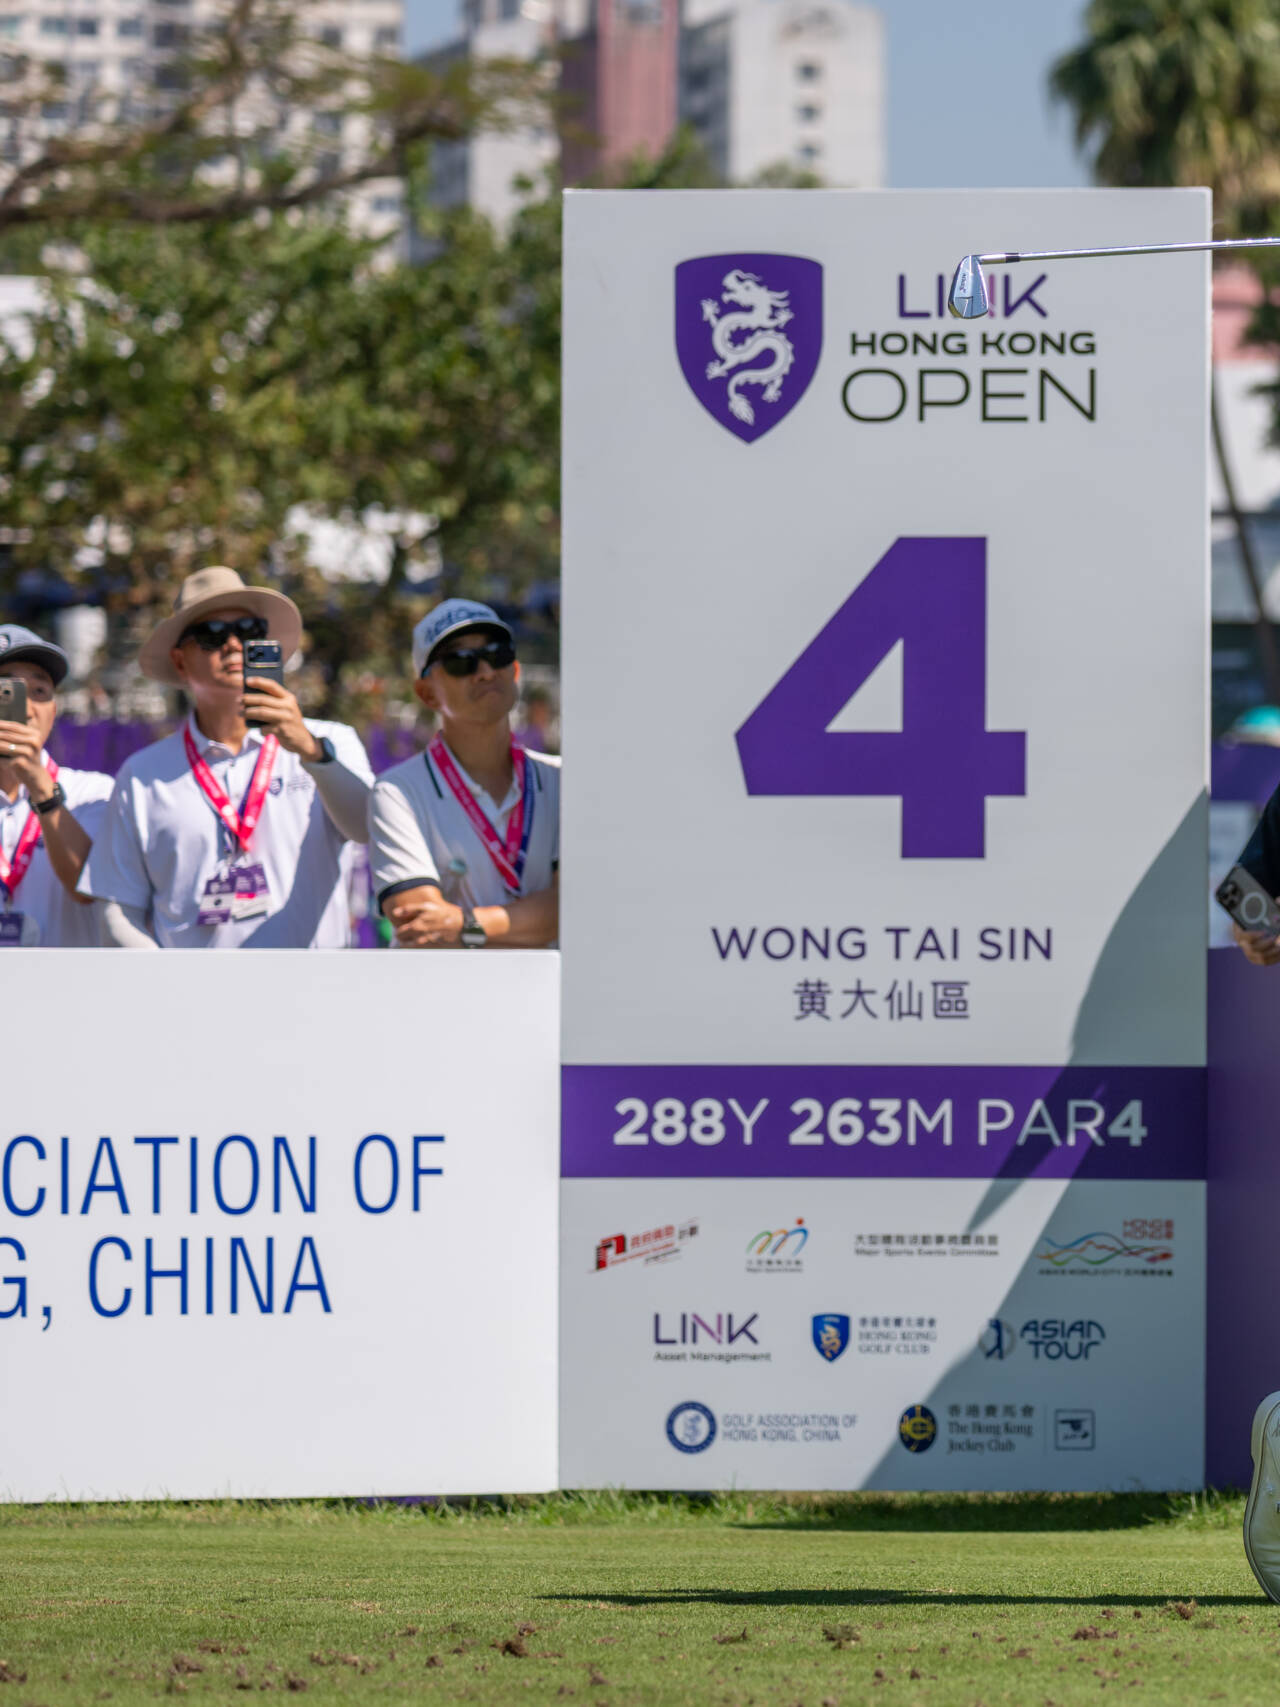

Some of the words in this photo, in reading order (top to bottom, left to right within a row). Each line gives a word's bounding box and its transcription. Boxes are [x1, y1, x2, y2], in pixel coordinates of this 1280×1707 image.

[850, 331, 969, 356] HONG
[981, 331, 1096, 356] KONG
[840, 367, 1097, 424] OPEN
[734, 536, 1028, 860] 4
[710, 926, 867, 961] WONG
[884, 926, 960, 961] TAI
[978, 926, 1053, 962] SIN
[612, 1097, 770, 1147] 288Y
[788, 1097, 954, 1147] 263M
[1, 1133, 318, 1218] CIATION
[353, 1133, 446, 1215] OF
[88, 1235, 333, 1319] CHINA
[653, 1312, 759, 1346] LINK
[1020, 1320, 1106, 1339] ASIAN
[654, 1351, 687, 1362] Asset
[690, 1351, 772, 1364] Management
[1027, 1340, 1101, 1361] TOUR
[722, 1414, 754, 1428] GOLF
[757, 1414, 840, 1428] ASSOCIATION
[842, 1414, 858, 1428] OF
[722, 1429, 757, 1442] HONG
[802, 1429, 841, 1442] CHINA
[948, 1421, 968, 1434] The
[971, 1421, 1001, 1437] Hong
[1003, 1421, 1033, 1437] Kong
